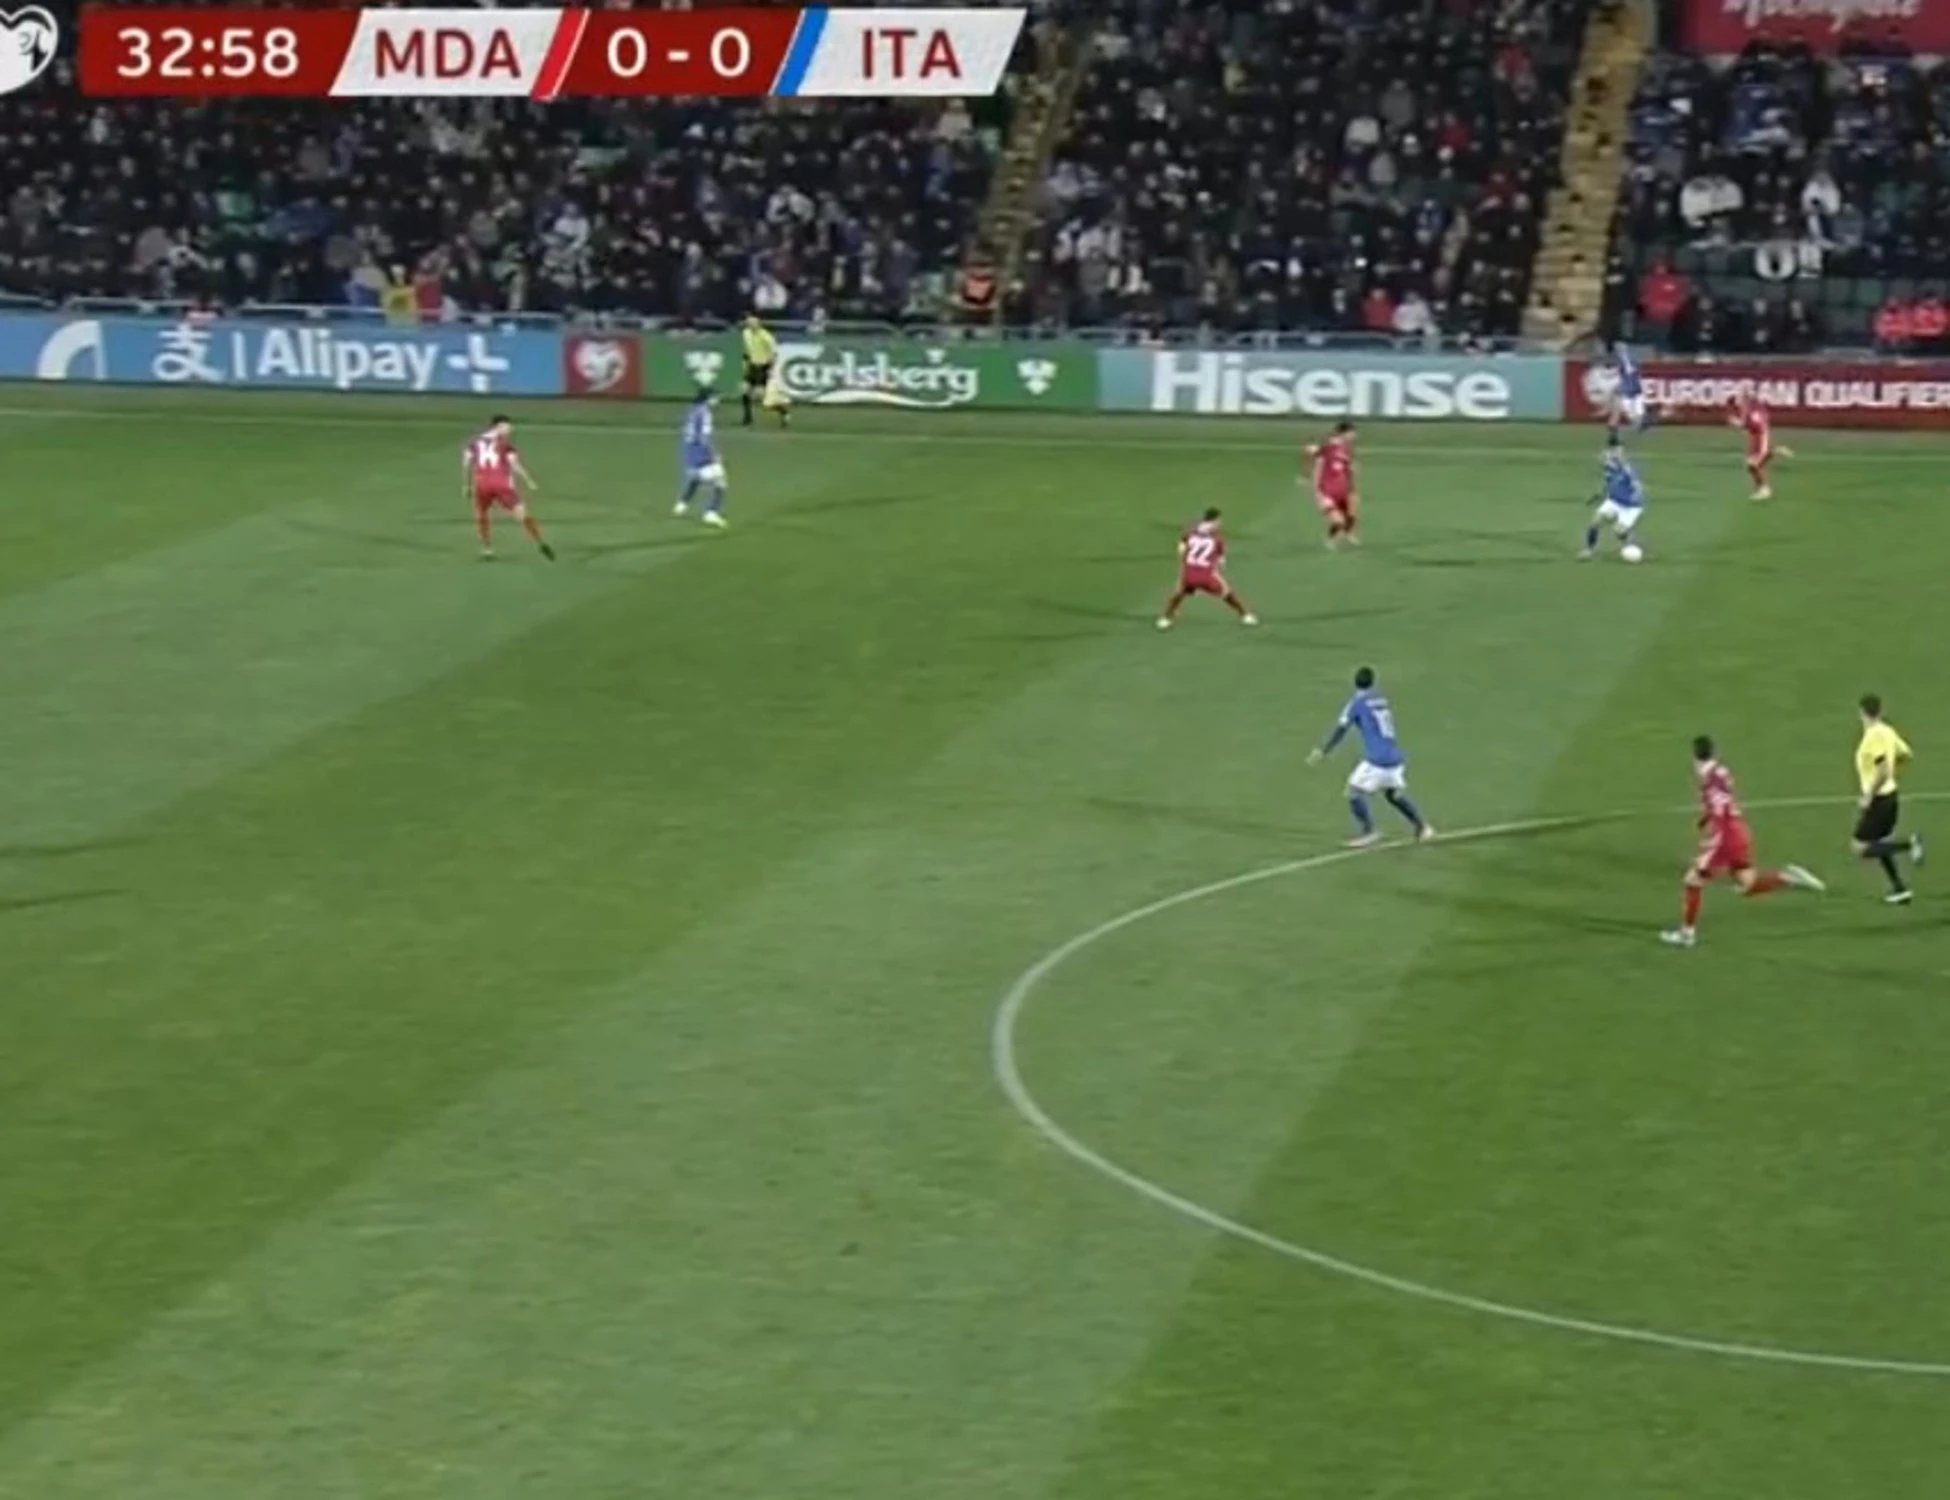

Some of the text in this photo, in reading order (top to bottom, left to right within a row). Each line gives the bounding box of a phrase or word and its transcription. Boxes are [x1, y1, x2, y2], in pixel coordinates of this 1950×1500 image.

[774, 343, 979, 402] Carlsberg
[1151, 351, 1510, 418] Hisense
[1187, 535, 1215, 567] 22
